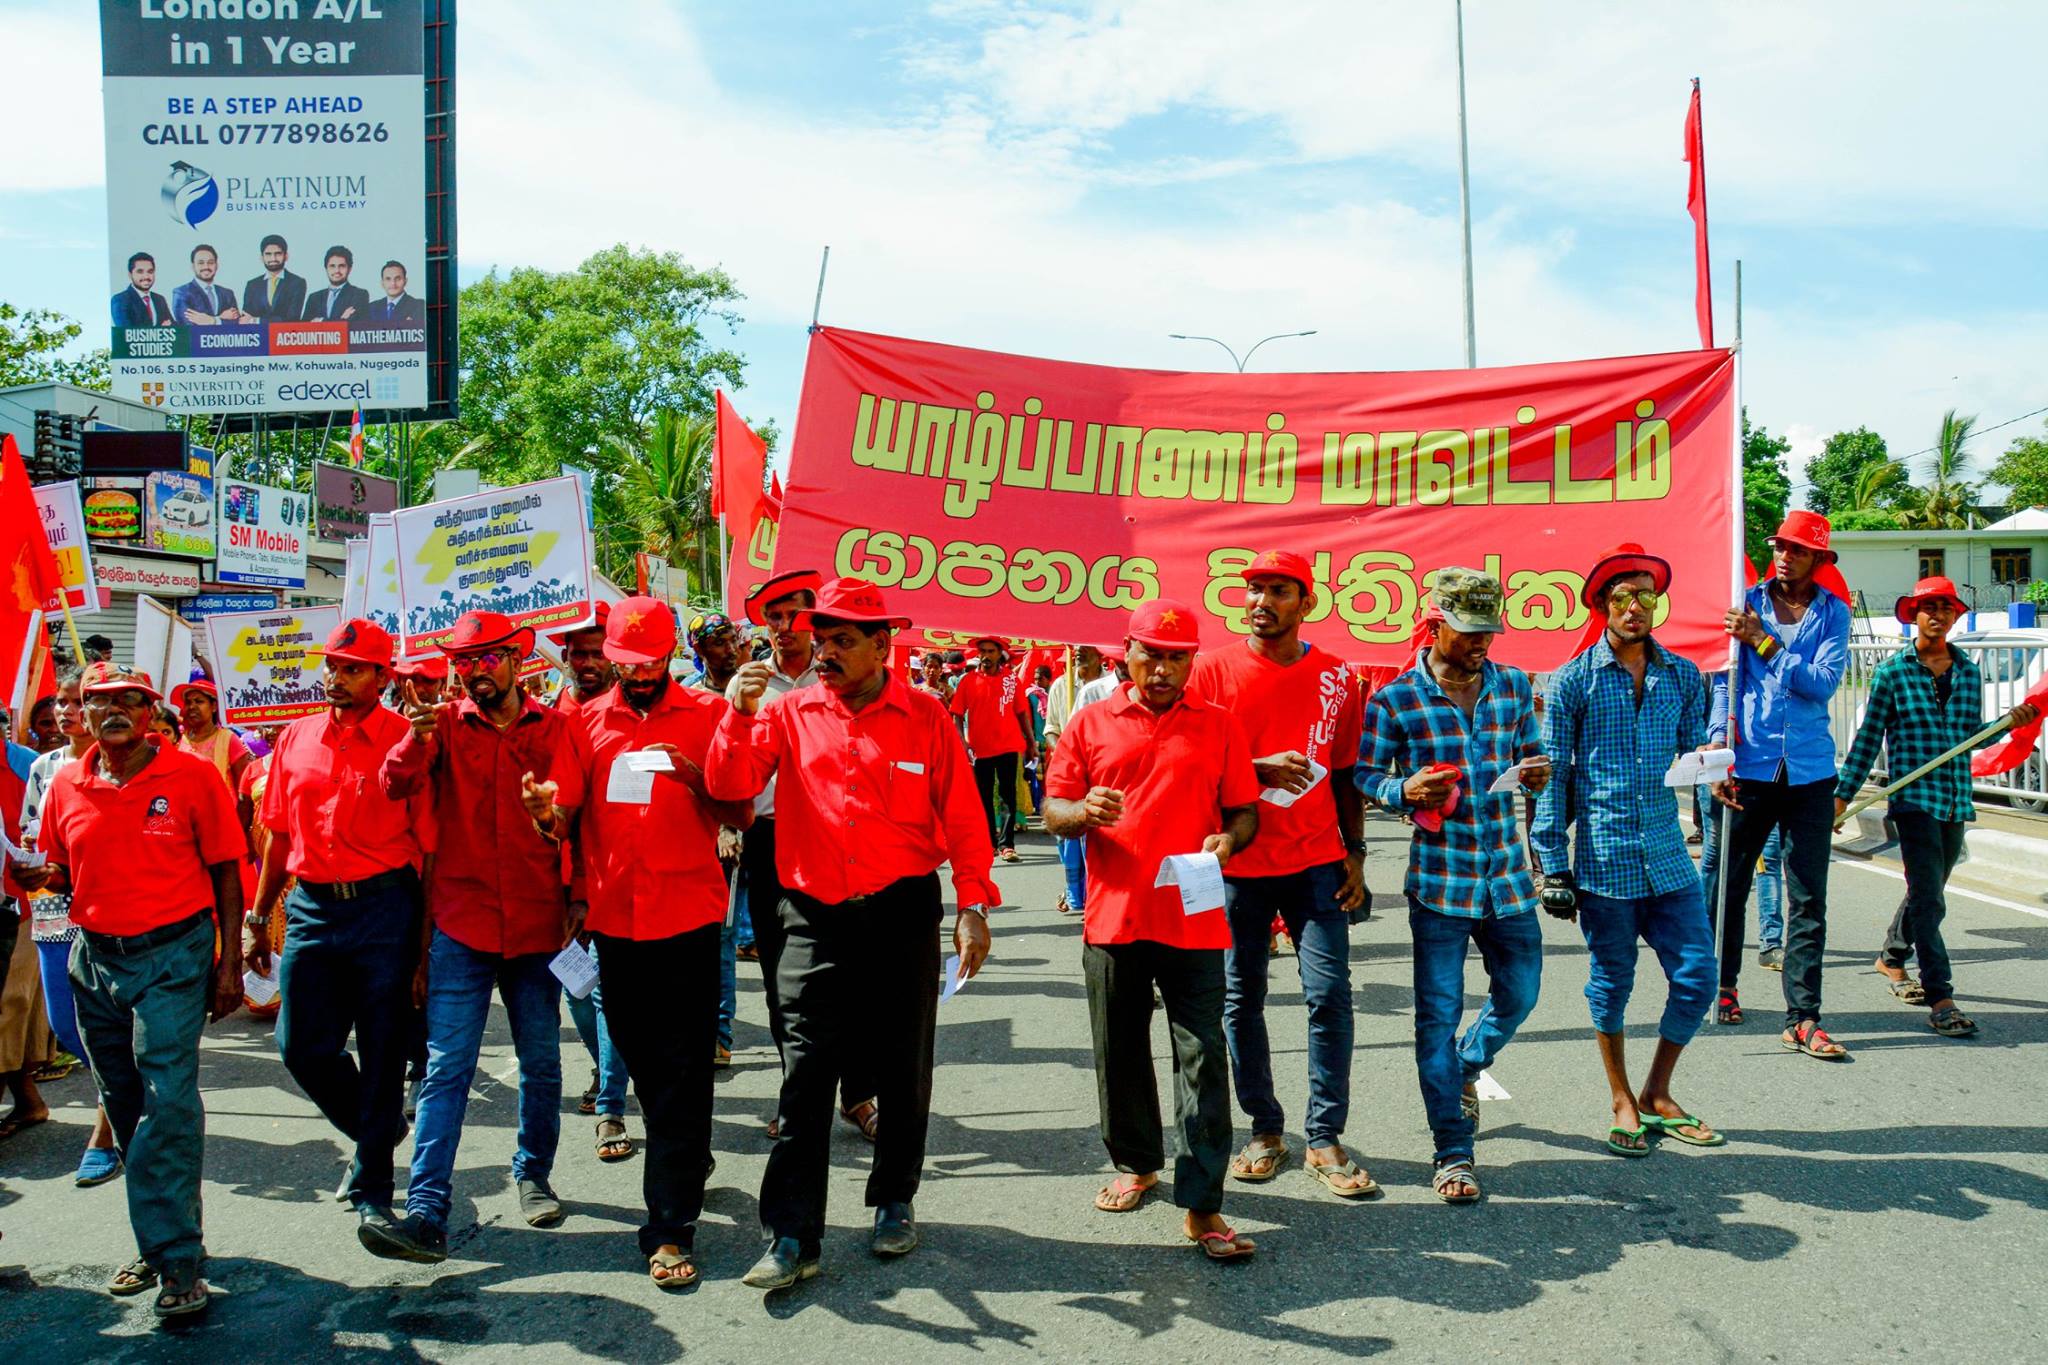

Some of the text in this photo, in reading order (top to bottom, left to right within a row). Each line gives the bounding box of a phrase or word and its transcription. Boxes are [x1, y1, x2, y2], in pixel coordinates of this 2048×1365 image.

[141, 0, 382, 23] London A/L
[170, 33, 356, 64] in 1 Year
[167, 96, 363, 114] BE A STEP AHEAD
[142, 122, 389, 145] CALL 0777898626
[226, 175, 366, 200] PLATINUM
[226, 200, 367, 212] BUSINESS ACADEMY
[125, 328, 176, 342] BUSINESS
[200, 333, 260, 348] ECONOMICS
[276, 331, 341, 346] ACCOUNTING
[350, 329, 424, 344] MATHEMATICS
[129, 343, 173, 356] STUDIES
[200, 362, 265, 375] Jayasinghe
[296, 360, 357, 370] Kohuwala,
[360, 358, 420, 370] Nugegoda
[169, 380, 266, 392] UNIVERSITY OF
[278, 379, 372, 400] edexcel
[170, 394, 266, 407] CAMBRIDGE
[850, 390, 1672, 520] யாழ்ப்பாணம் மாவட்டம்
[490, 494, 542, 520] முறையில்
[230, 524, 300, 554] SM Mobile
[447, 518, 534, 547] அதிகரிக்கப்பட்ட
[223, 548, 240, 558] Mobile
[834, 527, 1161, 611] යාපනය
[172, 576, 198, 588] පාසල
